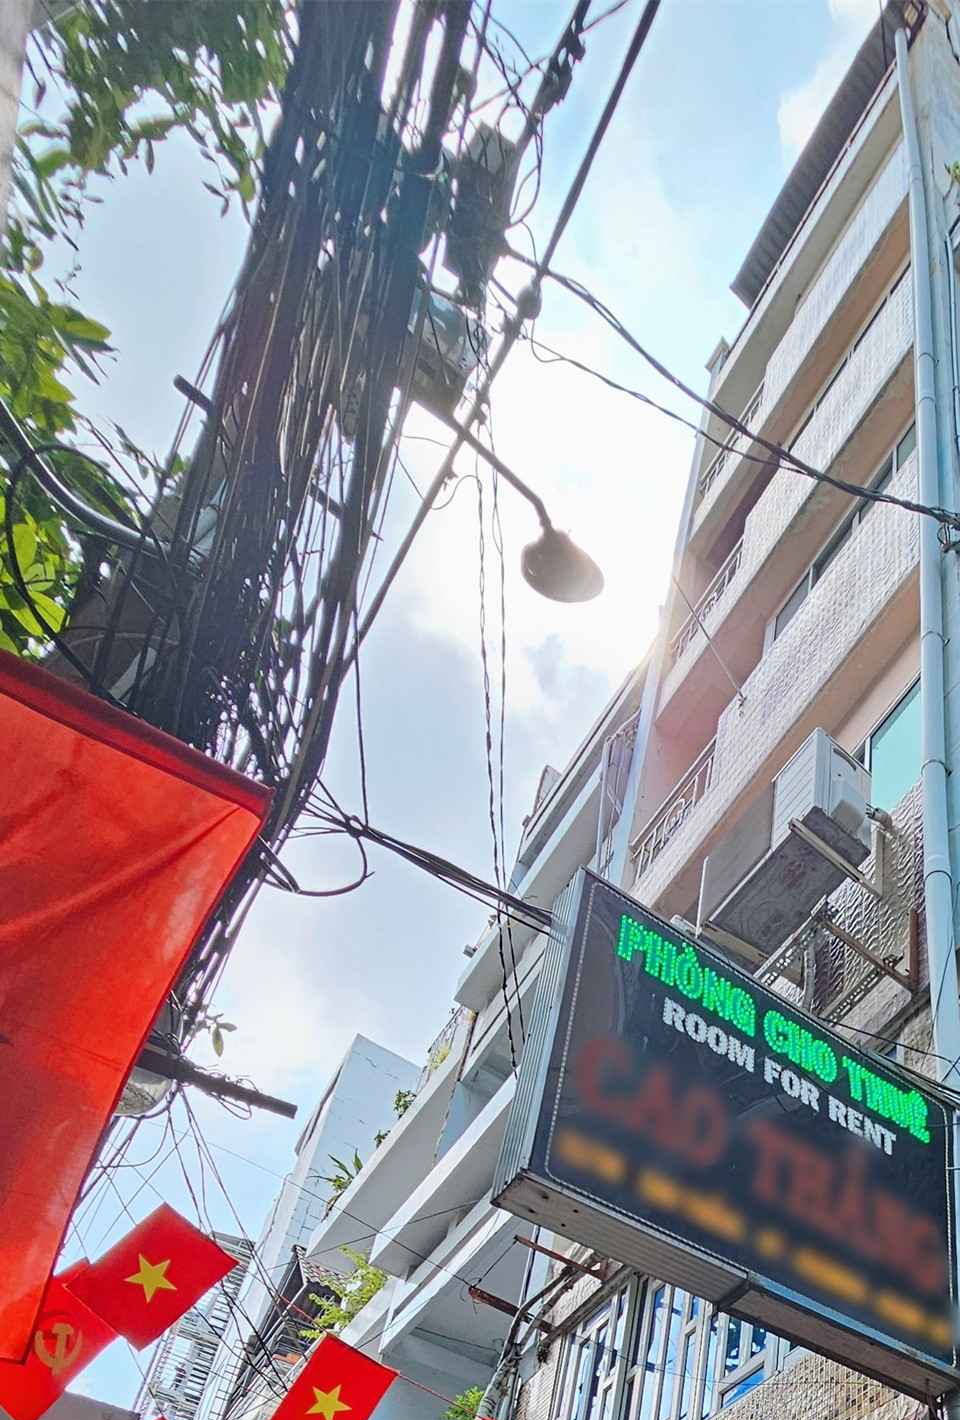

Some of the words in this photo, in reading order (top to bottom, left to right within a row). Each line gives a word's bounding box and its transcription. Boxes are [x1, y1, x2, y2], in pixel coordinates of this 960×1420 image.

[617, 914, 756, 1037] PHÒNG
[763, 1010, 838, 1083] CHO
[662, 996, 755, 1073] ROOM
[763, 1055, 820, 1112] FOR
[828, 1095, 897, 1156] RENT
